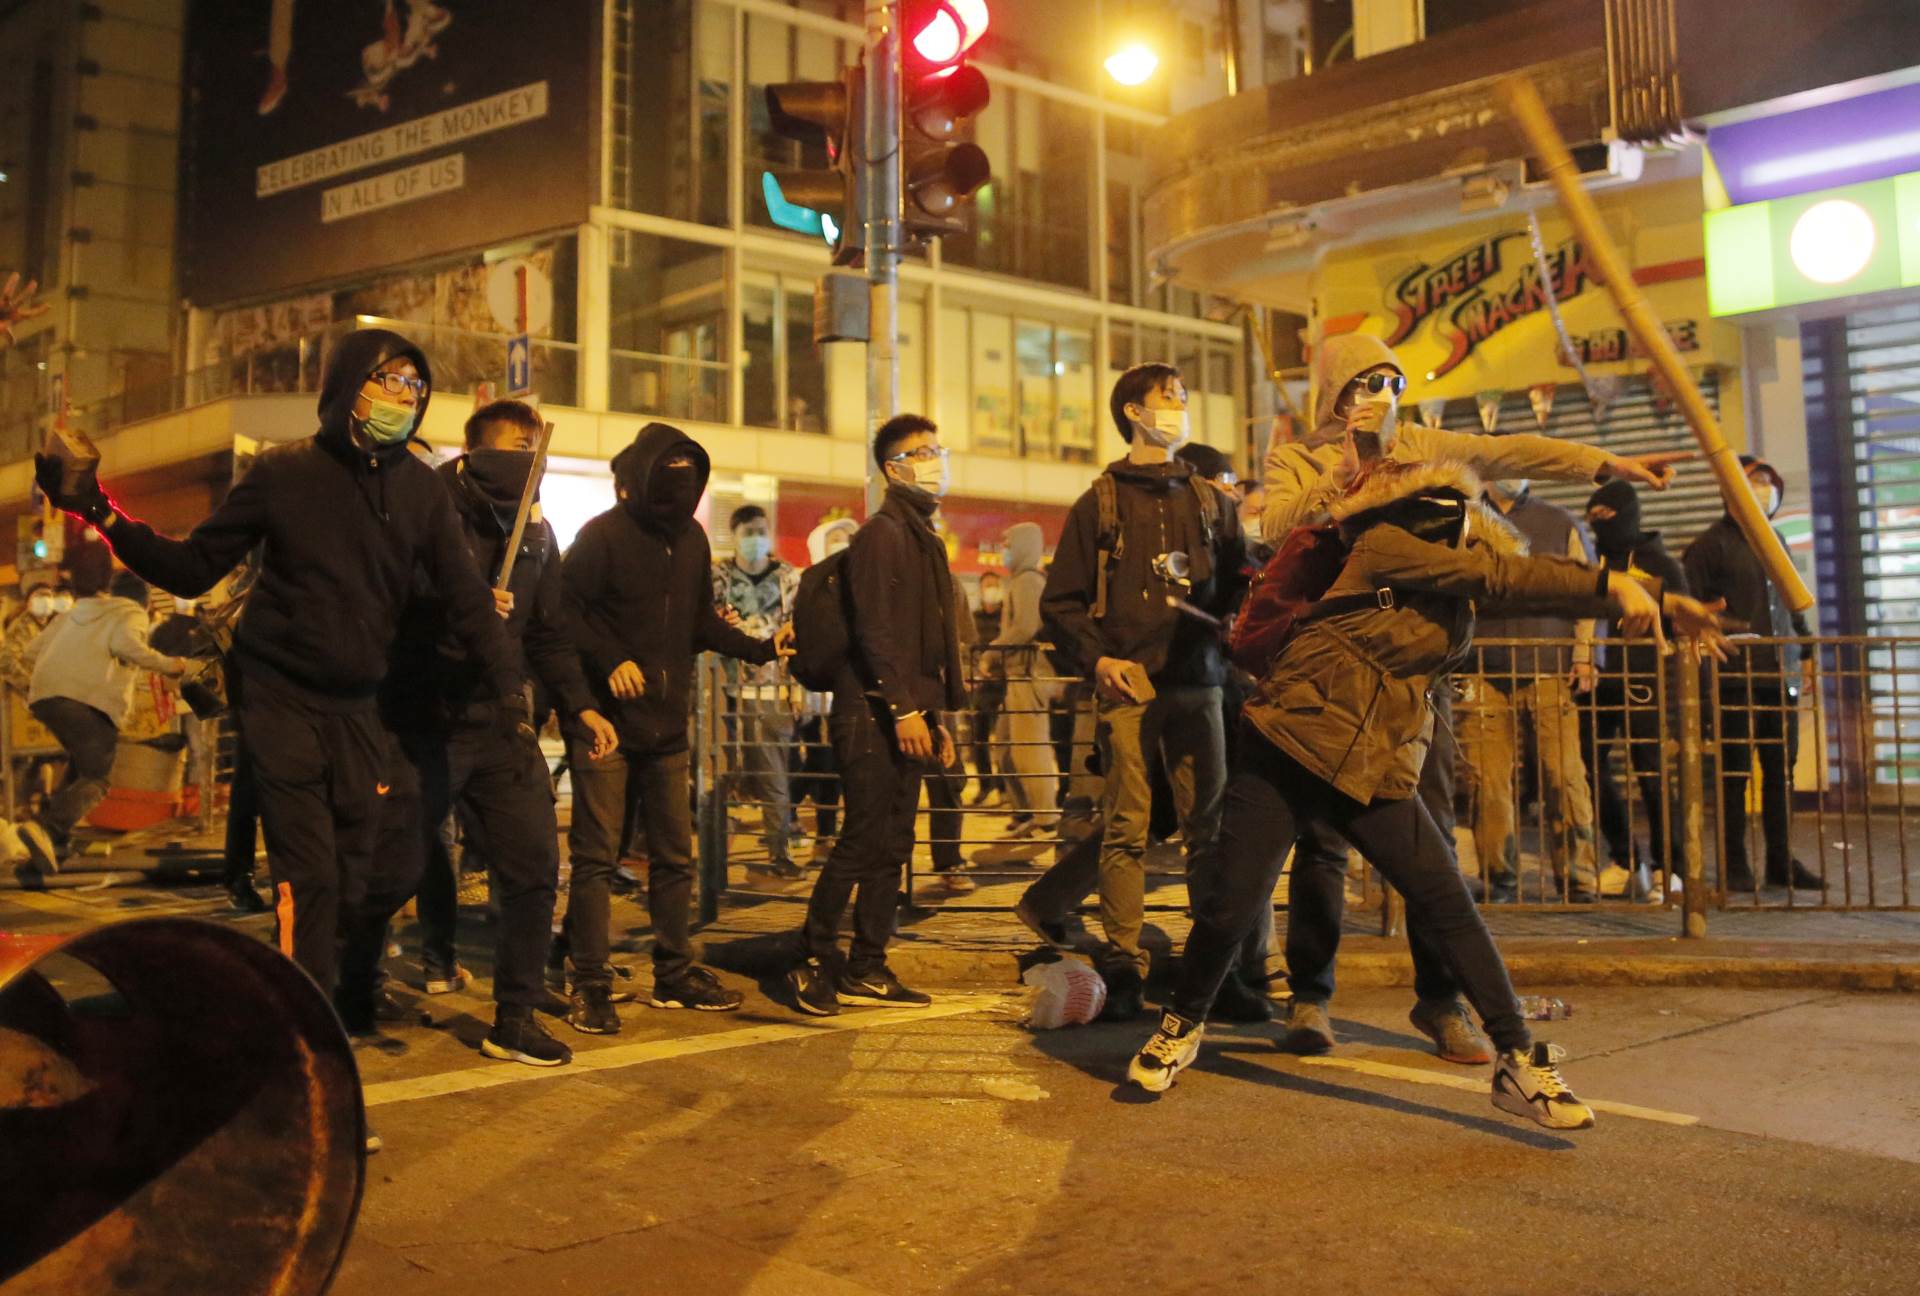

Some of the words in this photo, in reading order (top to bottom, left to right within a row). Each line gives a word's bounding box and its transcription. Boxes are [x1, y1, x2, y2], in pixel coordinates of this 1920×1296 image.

[258, 135, 386, 193] CELEBRATING
[394, 120, 433, 149] THE
[441, 90, 536, 136] MONKEY
[351, 181, 382, 207] ALL
[394, 168, 420, 197] OF
[430, 160, 456, 188] US
[1383, 231, 1528, 349] STREET
